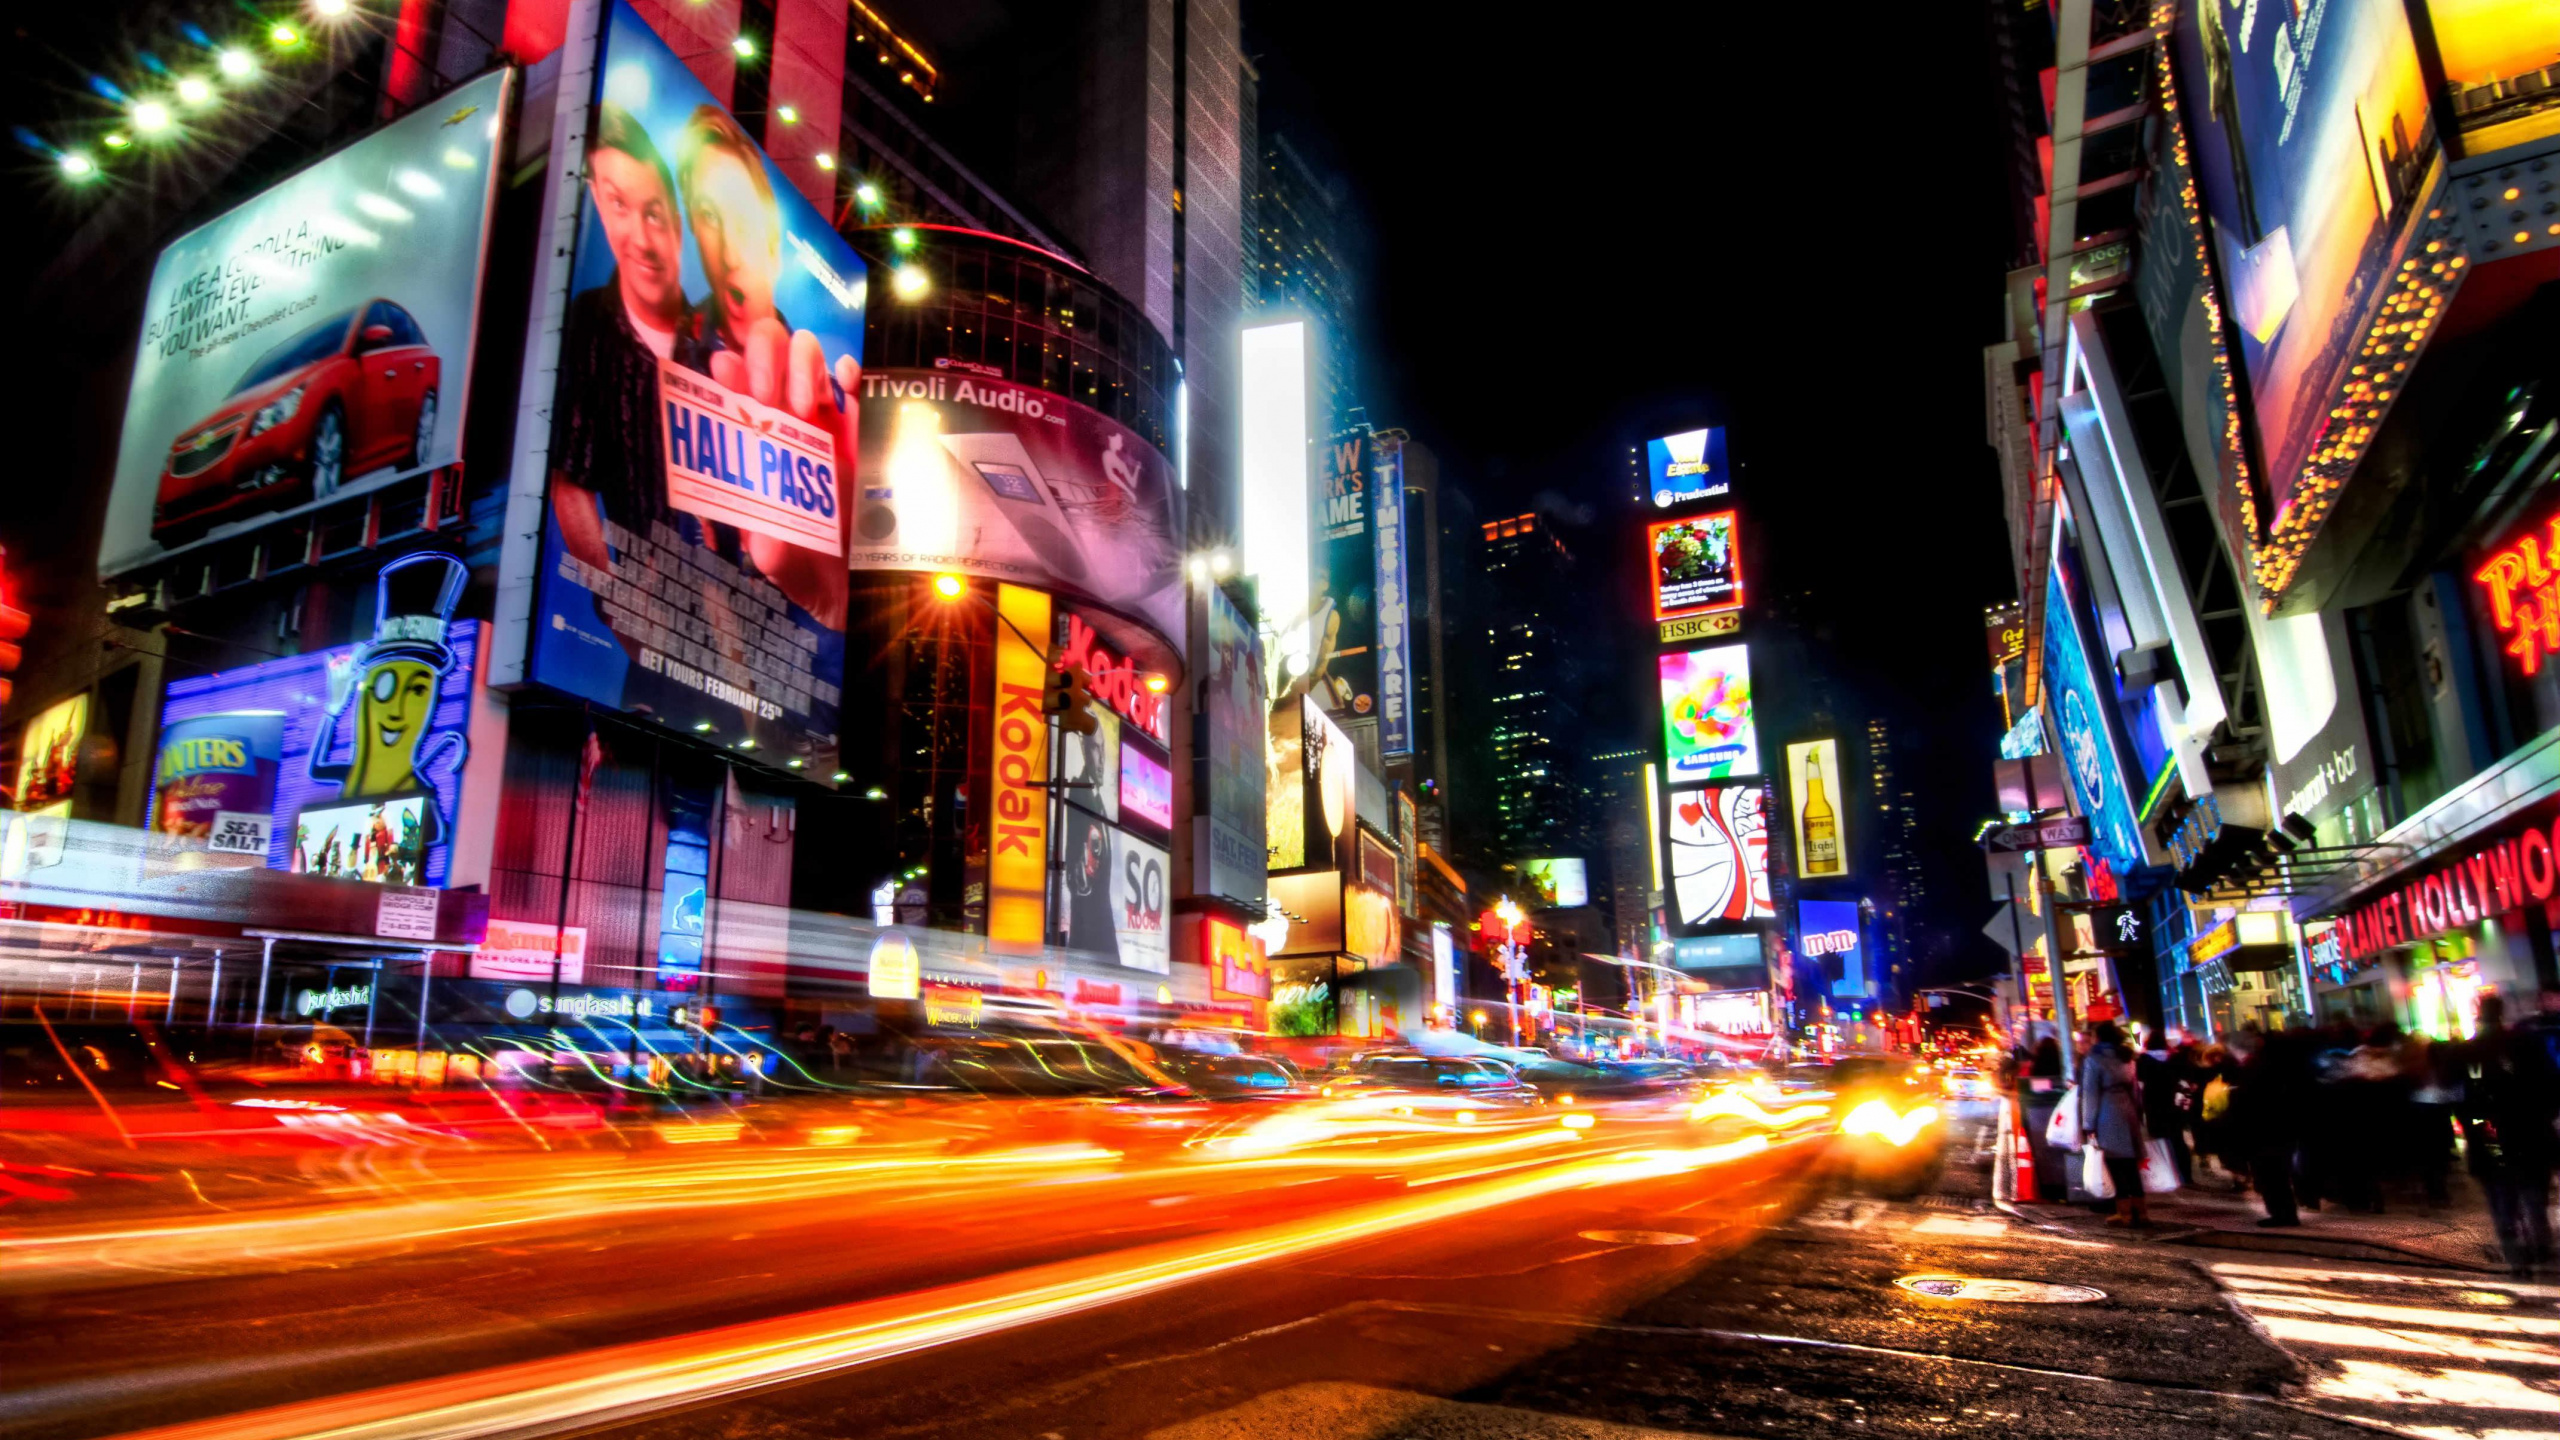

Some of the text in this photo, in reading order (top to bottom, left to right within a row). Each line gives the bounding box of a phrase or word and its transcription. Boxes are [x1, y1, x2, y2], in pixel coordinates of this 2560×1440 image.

[170, 272, 208, 308] LIKE
[209, 265, 221, 288] A
[147, 310, 179, 345] BUT
[181, 285, 226, 326] WITH
[160, 298, 250, 360] YOU WANT.
[206, 331, 239, 354] all-new
[241, 307, 287, 337] Chevrolet
[289, 295, 318, 316] Cruze
[862, 375, 946, 400] Tivoli
[953, 380, 1044, 418] Audio
[666, 400, 754, 492] HALL
[759, 439, 835, 518] PASS
[1317, 492, 1364, 528] AME
[1674, 482, 1729, 502] Prudential
[1374, 464, 1398, 573] TIMES
[865, 552, 899, 562] YEARS
[901, 553, 916, 562] OF
[920, 553, 953, 565] RADIO
[958, 556, 1024, 576] PERFECTION
[1661, 618, 1711, 638] HSBC
[1380, 581, 1405, 719] SQUARE
[640, 647, 783, 721] GET YOURS FEBRUARY 25TH
[1063, 613, 1165, 740] Kodak
[163, 738, 247, 778] NTERS
[997, 682, 1042, 858] Kodak
[1683, 750, 1740, 766] SAMSUNG
[2333, 744, 2357, 784] bar
[213, 834, 266, 851] SALT
[223, 820, 259, 836] SEA
[1808, 840, 1834, 852] Light
[2002, 827, 2076, 845] ONE WAY
[1125, 849, 1163, 918] SO
[2336, 890, 2404, 959] PLANET
[2406, 815, 2560, 940] HOLLYWO
[476, 954, 499, 962] NEW
[503, 956, 530, 964] YORK
